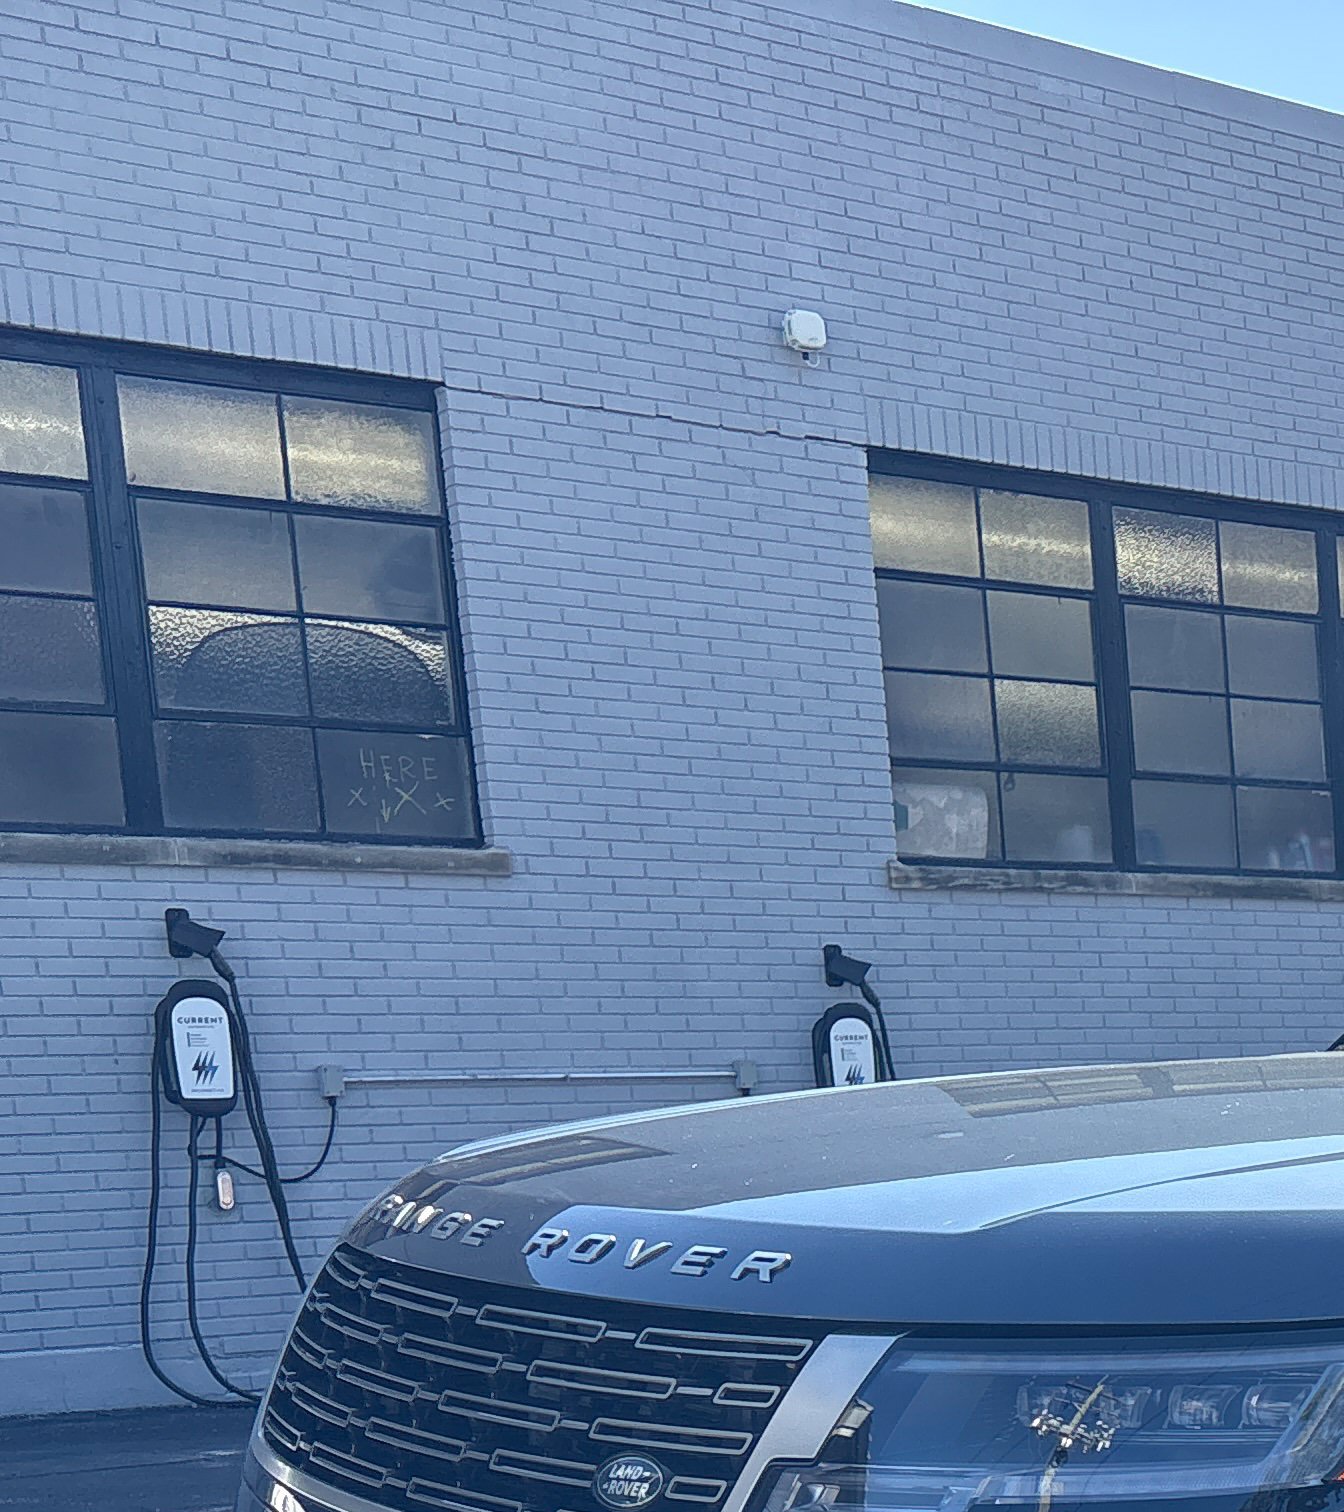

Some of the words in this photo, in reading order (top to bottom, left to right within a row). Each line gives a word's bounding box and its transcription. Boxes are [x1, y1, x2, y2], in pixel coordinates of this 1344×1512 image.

[360, 748, 438, 782] HERE
[177, 1016, 223, 1025] CURRENT
[371, 1193, 505, 1247] RANGE
[521, 1227, 794, 1283] ROVER
